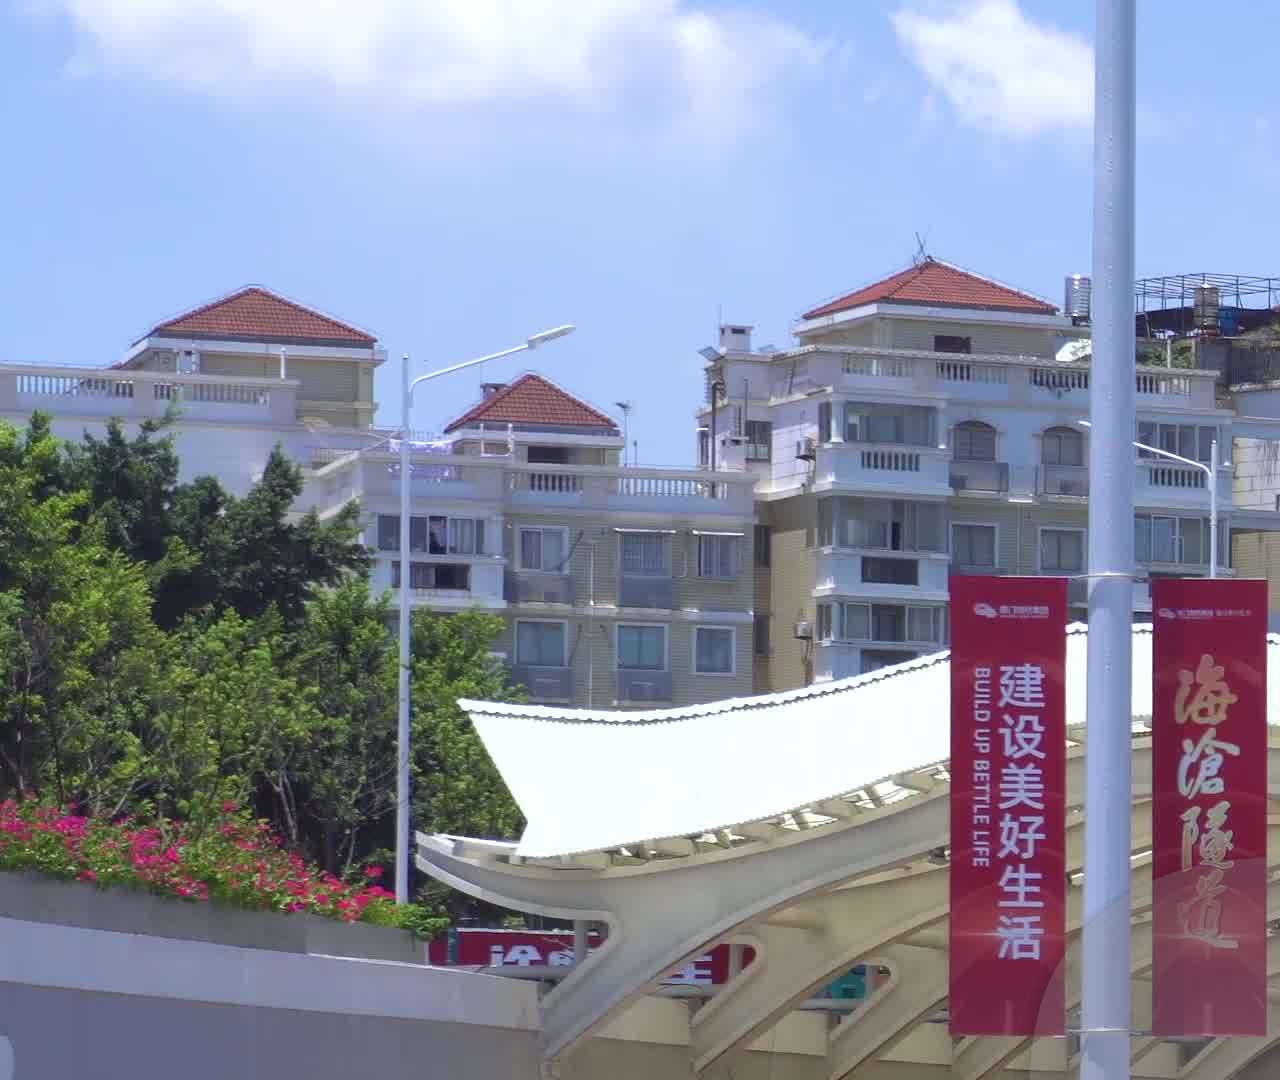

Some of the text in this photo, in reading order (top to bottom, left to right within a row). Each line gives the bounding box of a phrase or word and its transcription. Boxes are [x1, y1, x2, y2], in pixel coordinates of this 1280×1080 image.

[972, 667, 991, 868] BUILD UP BETTLE LIFE
[997, 663, 1047, 961] 建设美好生活
